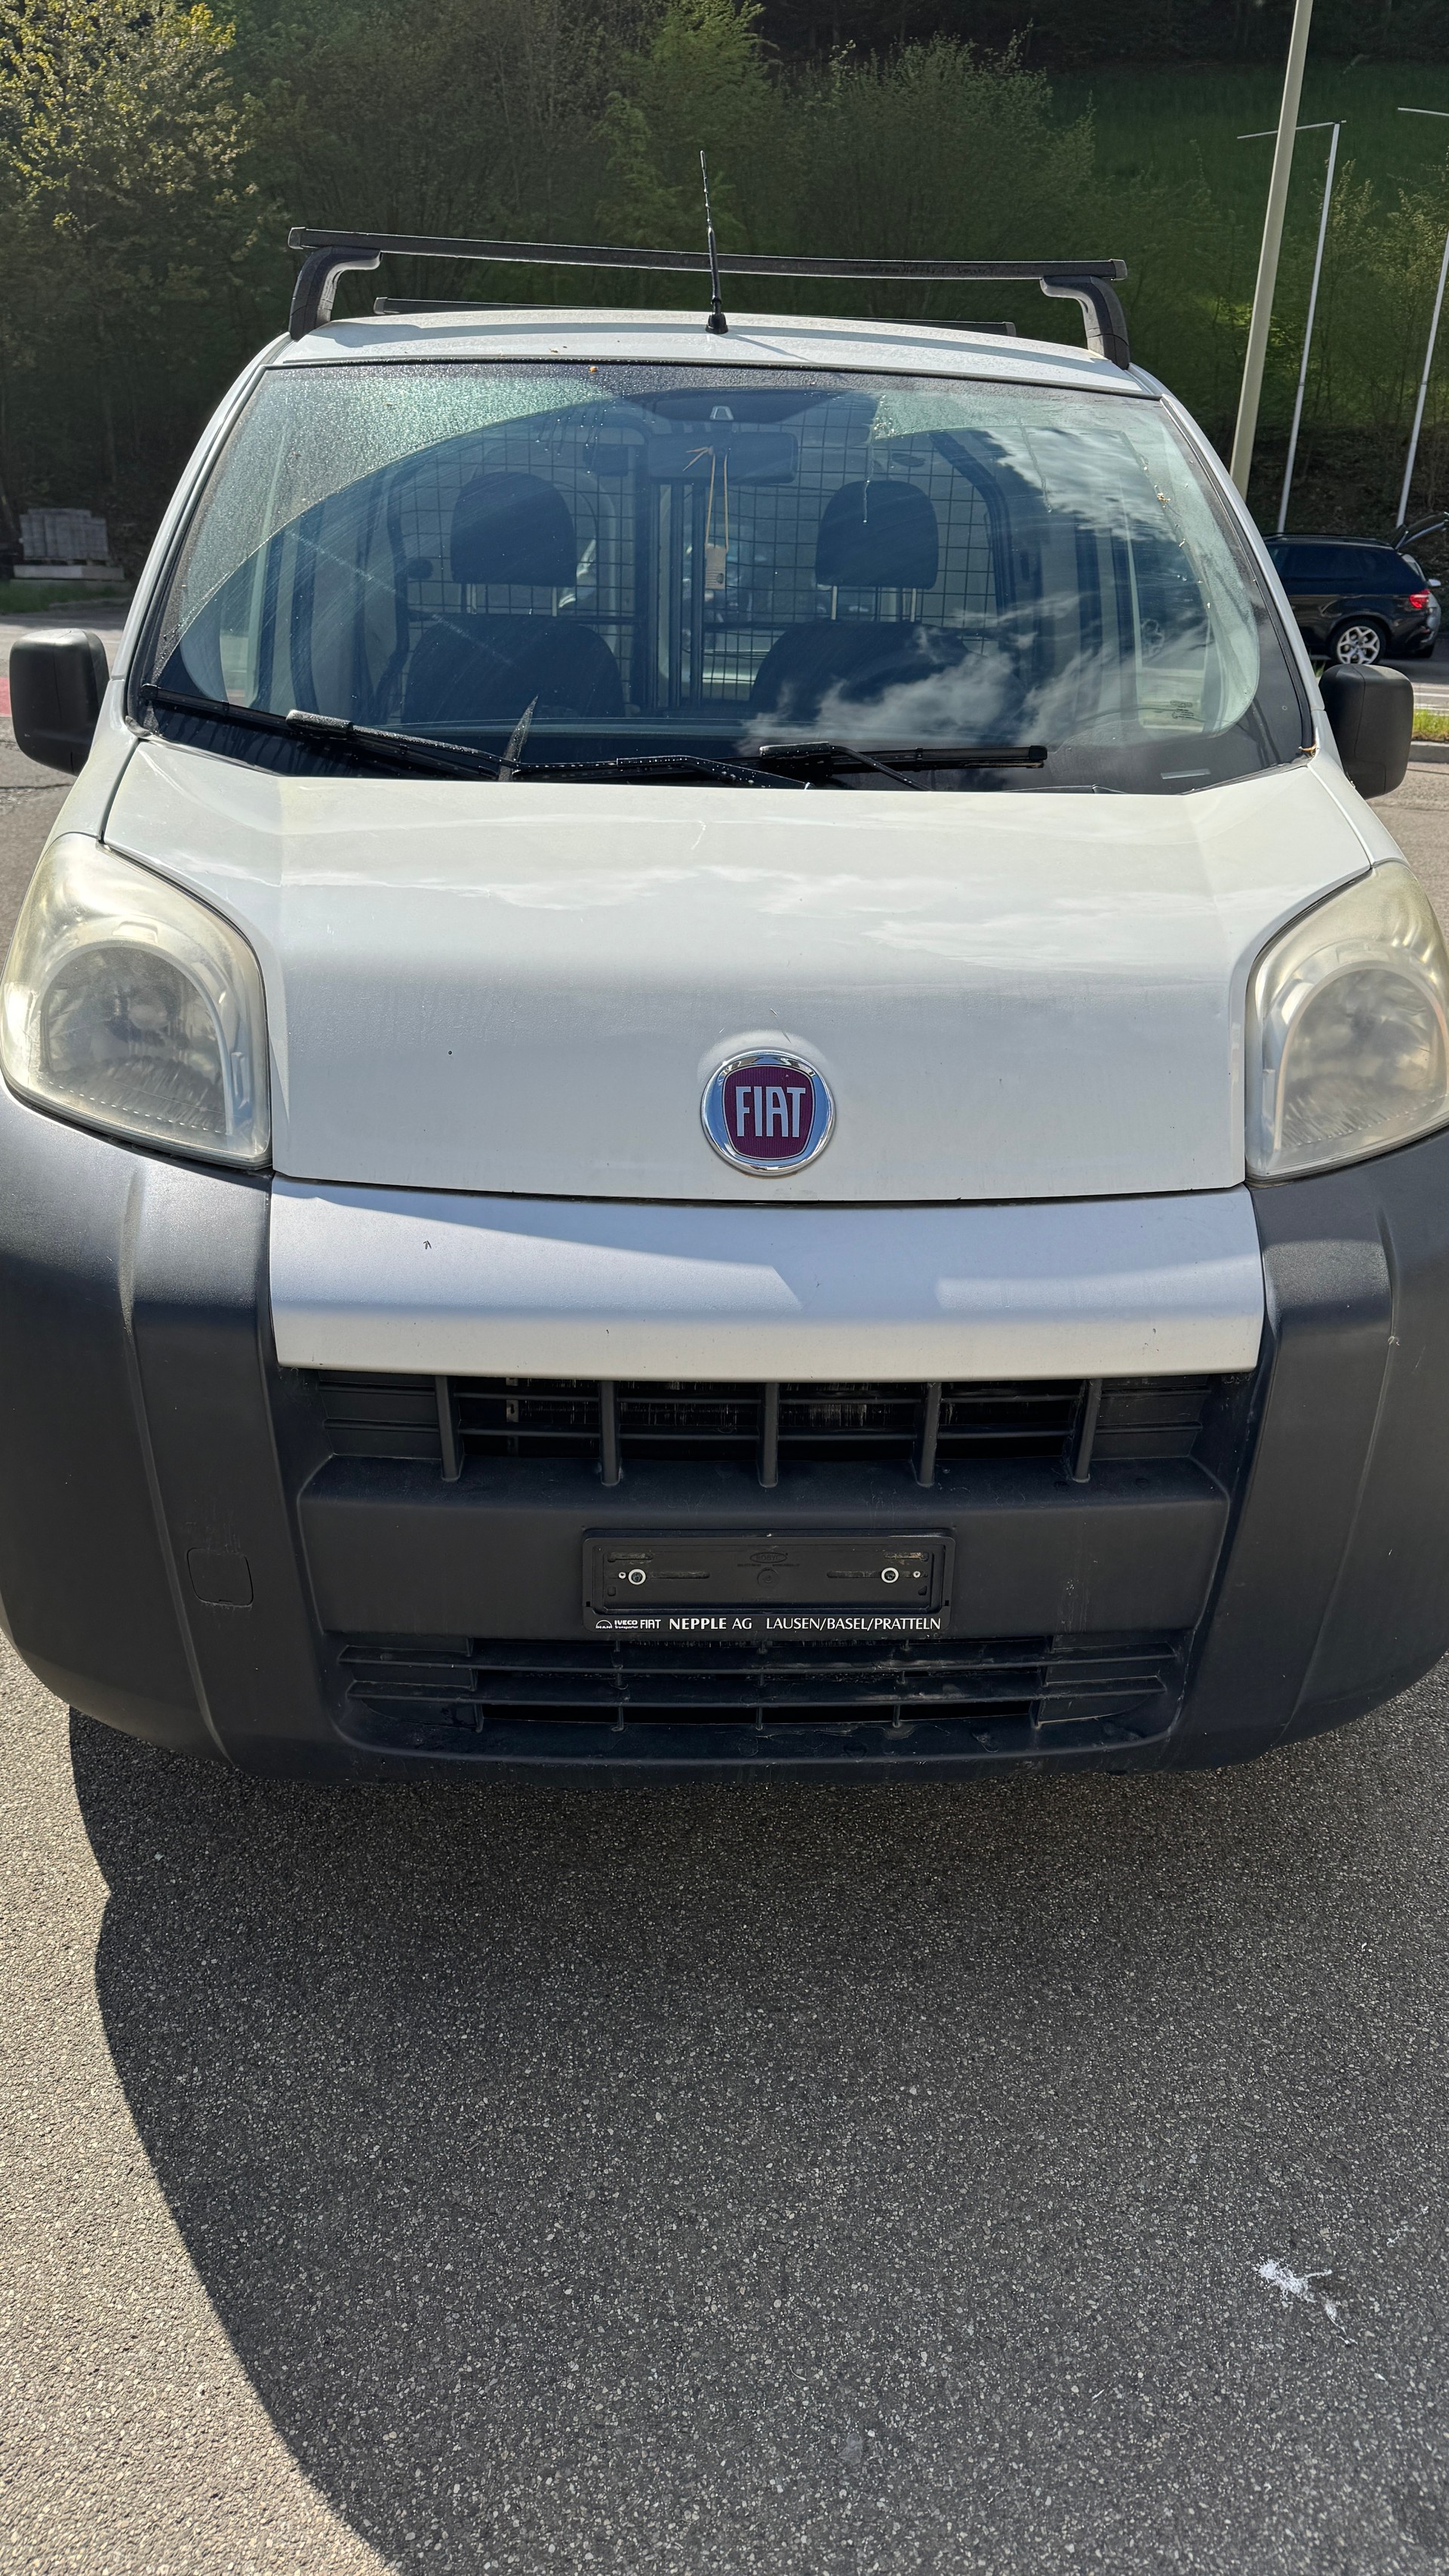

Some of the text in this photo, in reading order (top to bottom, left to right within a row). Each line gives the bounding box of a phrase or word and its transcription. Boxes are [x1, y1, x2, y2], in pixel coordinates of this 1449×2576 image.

[736, 1086, 806, 1138] FIAT
[640, 1617, 941, 1632] FIAT NEPPLE AG LAUSEN/BASEL/PRATTELN
